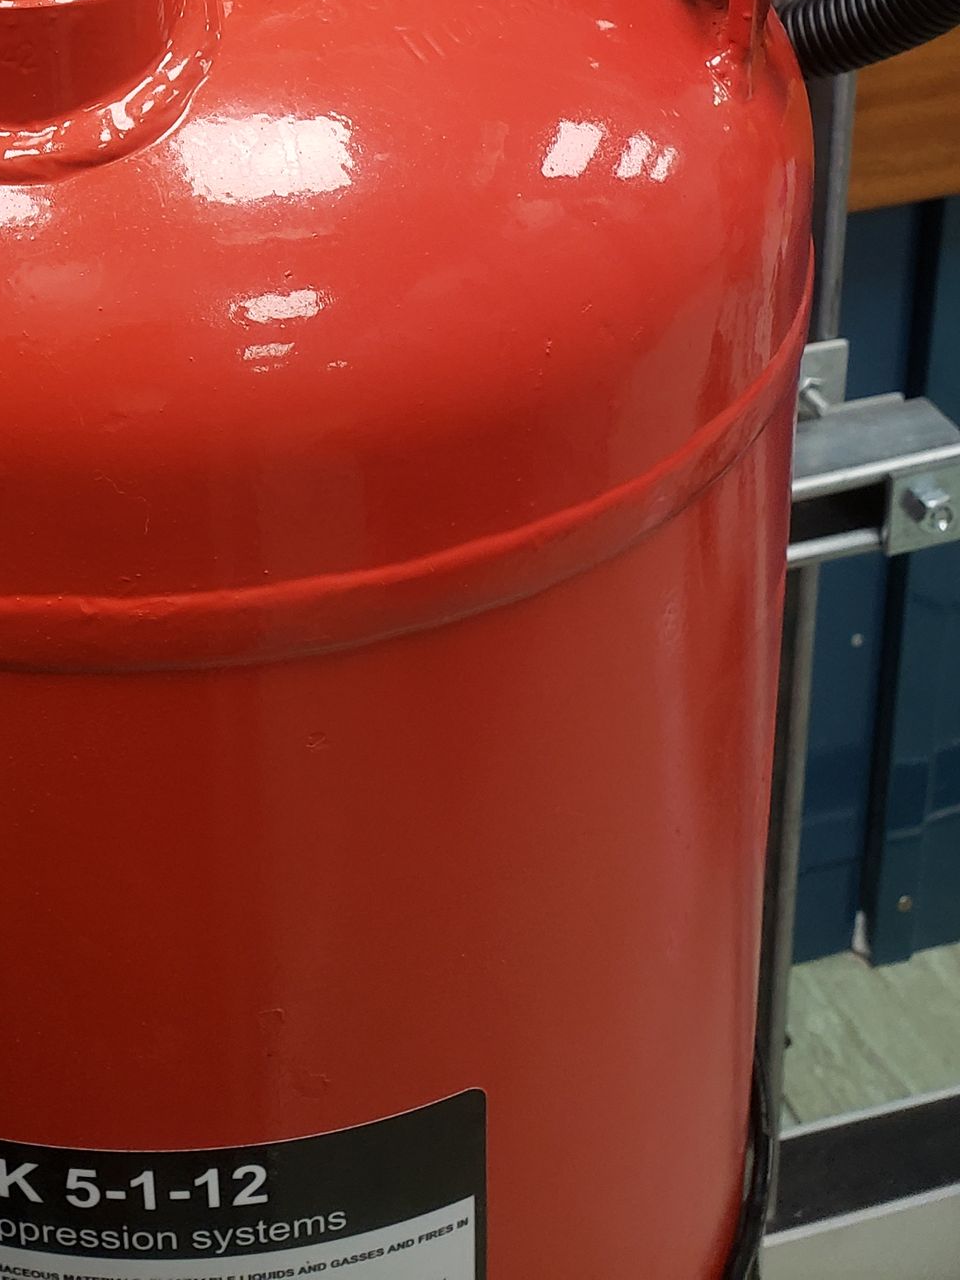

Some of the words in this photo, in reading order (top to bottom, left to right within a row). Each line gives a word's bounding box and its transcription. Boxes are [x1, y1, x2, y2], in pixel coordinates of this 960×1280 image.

[65, 1164, 269, 1211] 5-1-12
[192, 1210, 348, 1254] systems
[298, 1262, 327, 1276] AND
[330, 1247, 385, 1269] GASSES
[387, 1238, 415, 1255] AND
[418, 1224, 454, 1244] FIRES
[456, 1217, 469, 1230] IN
